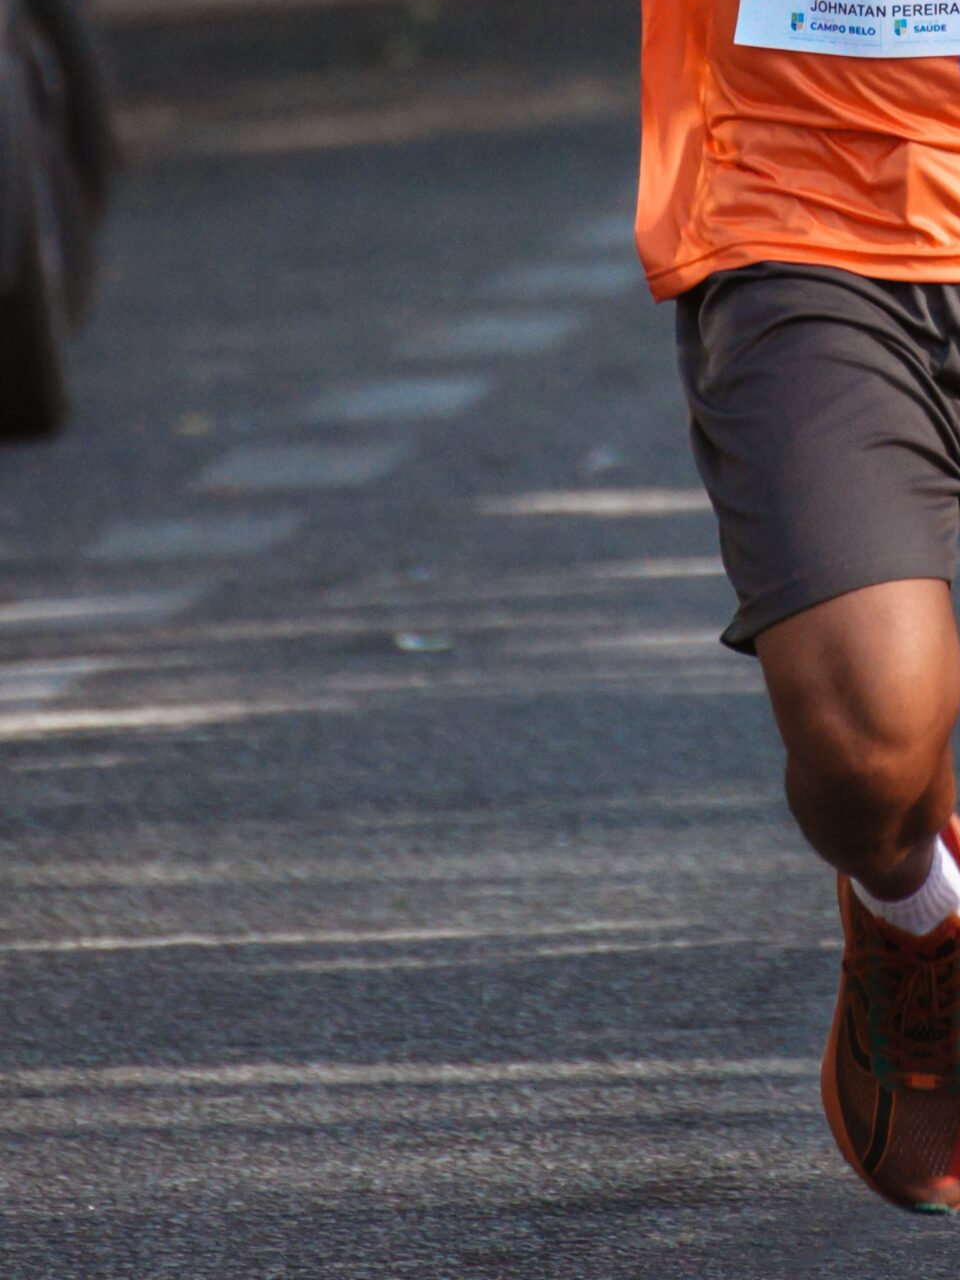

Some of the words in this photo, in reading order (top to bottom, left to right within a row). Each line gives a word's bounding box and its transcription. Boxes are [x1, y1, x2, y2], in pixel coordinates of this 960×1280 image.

[810, 0, 886, 18] JOHNATAN
[892, 2, 960, 17] PEREIRA
[810, 21, 847, 34] CAMPO
[849, 24, 877, 36] BELO
